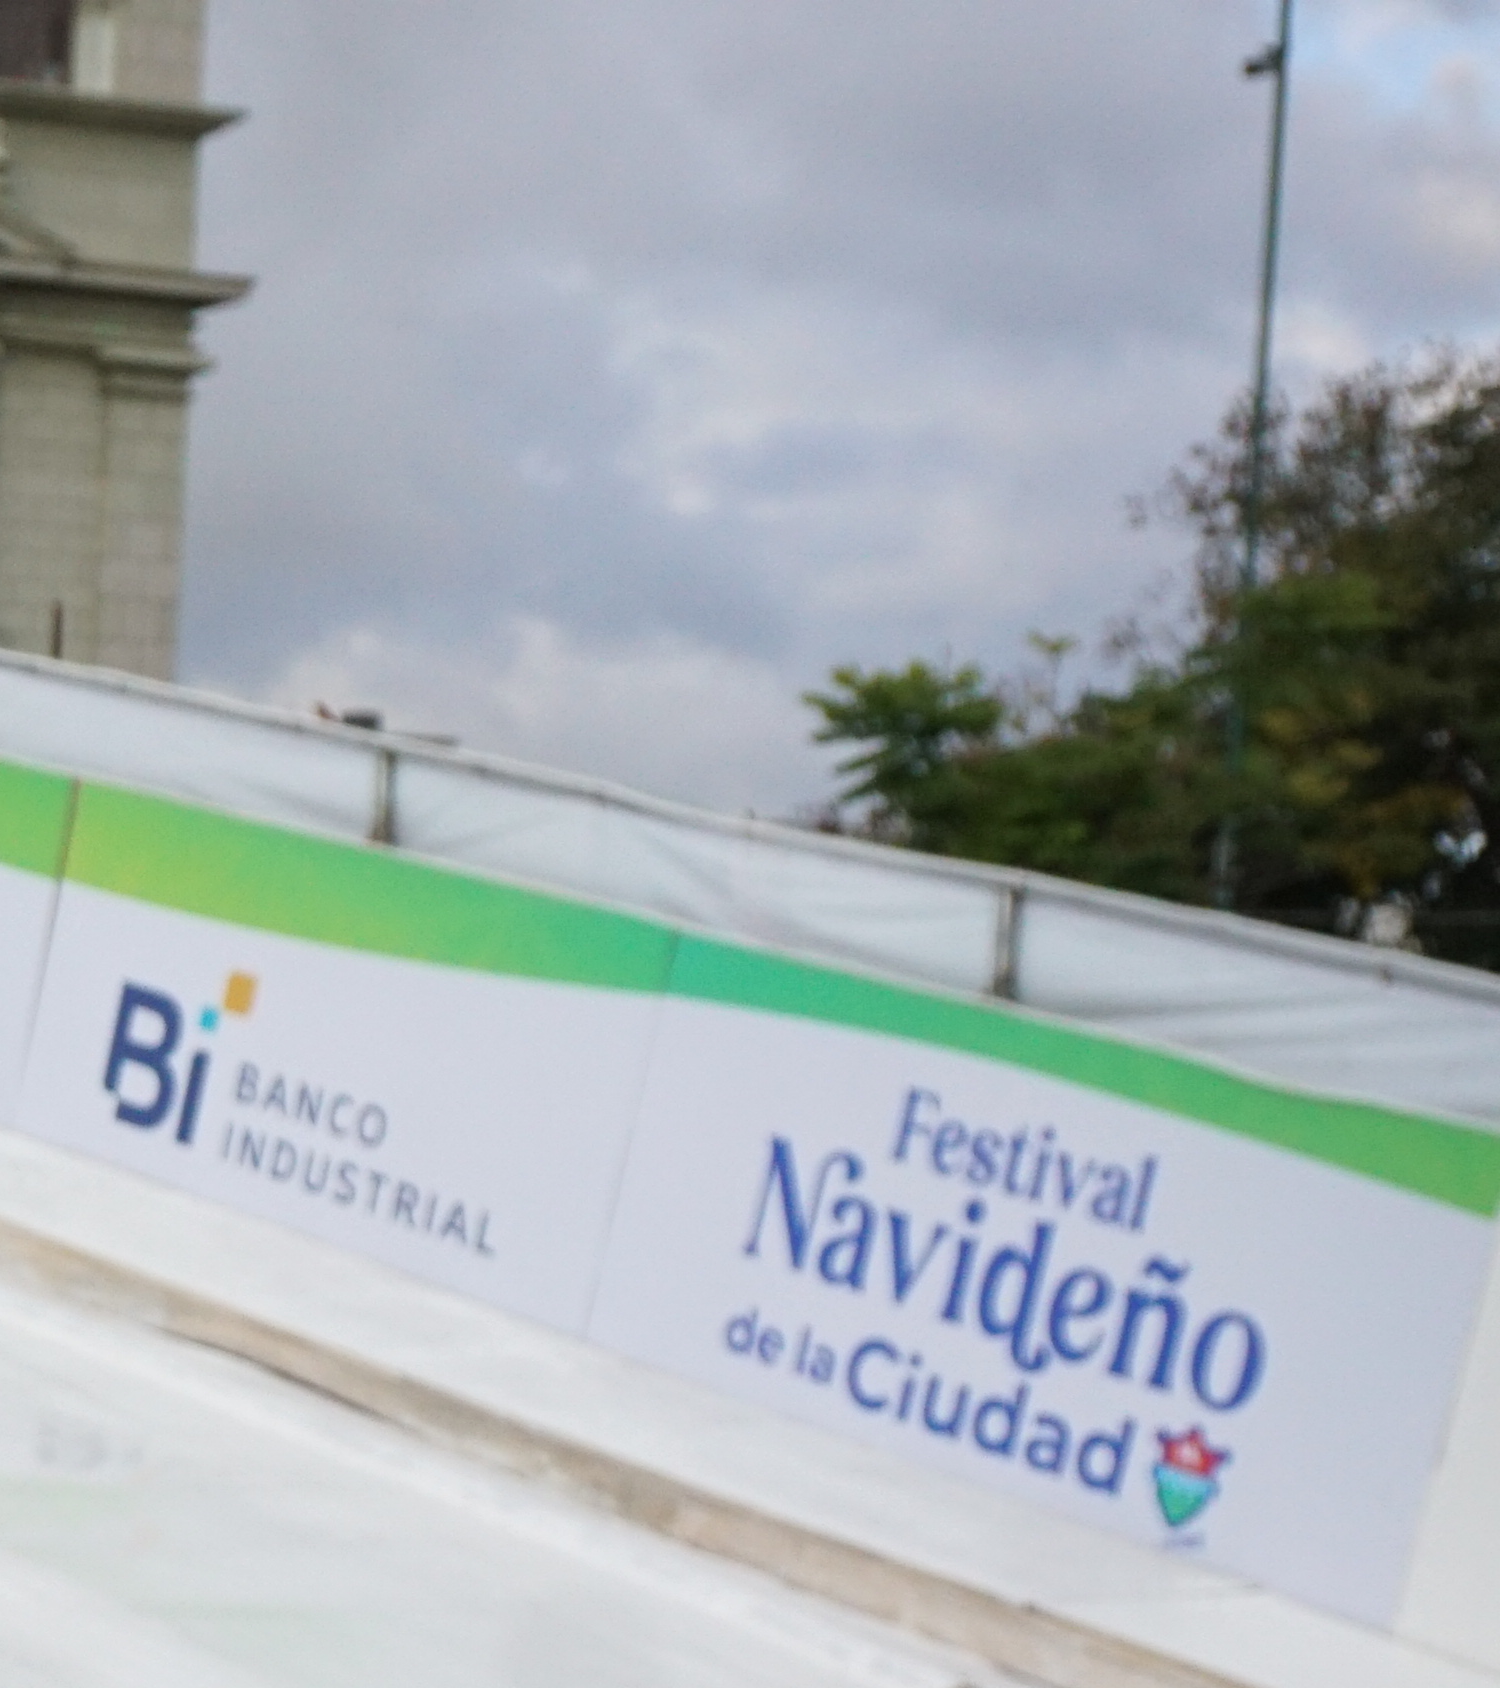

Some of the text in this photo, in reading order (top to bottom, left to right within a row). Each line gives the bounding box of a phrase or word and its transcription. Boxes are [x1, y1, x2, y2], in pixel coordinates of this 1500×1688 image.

[103, 978, 225, 1146] Bi
[233, 1062, 388, 1149] BANCO
[222, 1123, 496, 1256] INDUSTRIAL
[893, 1087, 1160, 1232] Festival
[743, 1136, 1268, 1412] Navideño
[724, 1306, 1138, 1496] de la Ciudad
